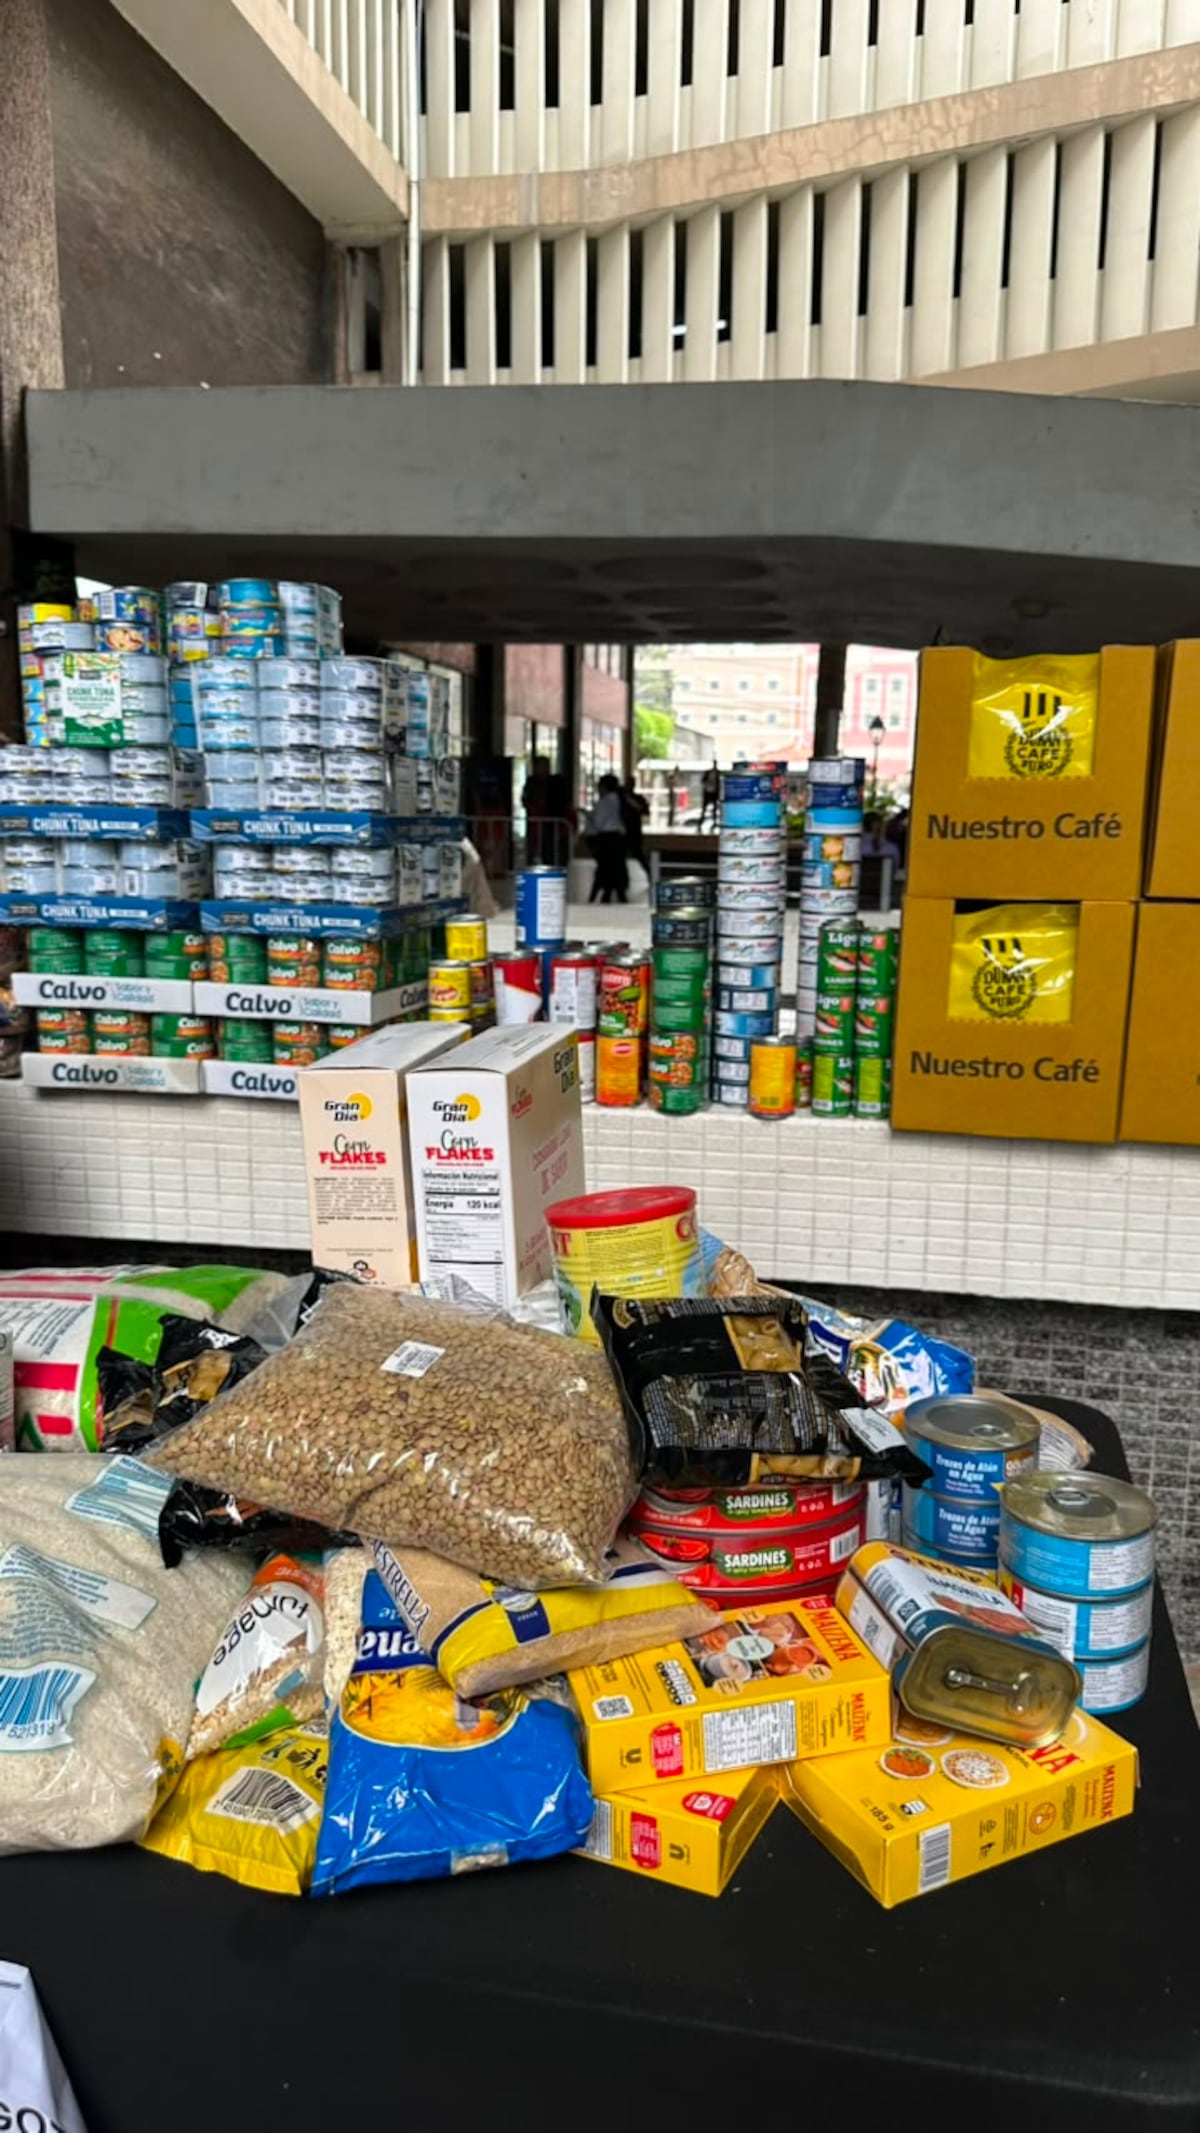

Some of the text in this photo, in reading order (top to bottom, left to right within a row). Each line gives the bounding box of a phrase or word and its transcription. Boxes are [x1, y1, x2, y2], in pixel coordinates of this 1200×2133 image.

[1016, 748, 1060, 760] CAFE
[31, 817, 69, 831] CHUNK
[71, 818, 99, 833] TUNA
[243, 819, 282, 834] CHUNK
[283, 821, 311, 836] TUNA
[927, 812, 1122, 840] Nuestro Café
[40, 903, 78, 918] CHUNK
[79, 905, 109, 919] TUNA
[253, 912, 291, 927] CHUNK
[292, 914, 321, 928] TUNA
[39, 979, 107, 1001] Calvo
[983, 985, 1026, 997] CAFE
[225, 992, 292, 1014] Calvo
[51, 1062, 119, 1084] Calvo
[909, 1051, 1100, 1083] Nuestro Café
[231, 1070, 296, 1094] Calvo
[324, 1100, 361, 1111] Gran
[432, 1100, 469, 1112] Gran
[333, 1132, 372, 1156] Corn
[440, 1128, 479, 1152] Corn
[318, 1151, 387, 1165] FLAKES
[424, 1147, 495, 1161] FLAKES
[936, 1453, 963, 1471] Trozos
[964, 1460, 977, 1472] de
[948, 1469, 985, 1482] en Agua
[725, 1491, 789, 1510] SARDINES
[939, 1507, 965, 1524] Trozos
[967, 1514, 979, 1525] de
[951, 1523, 987, 1537] en Agua
[724, 1549, 787, 1568] SARDINES
[805, 1609, 863, 1663] MAIZENA
[851, 1692, 867, 1743] MAIZENA
[1100, 1763, 1116, 1819] MAIZENA
